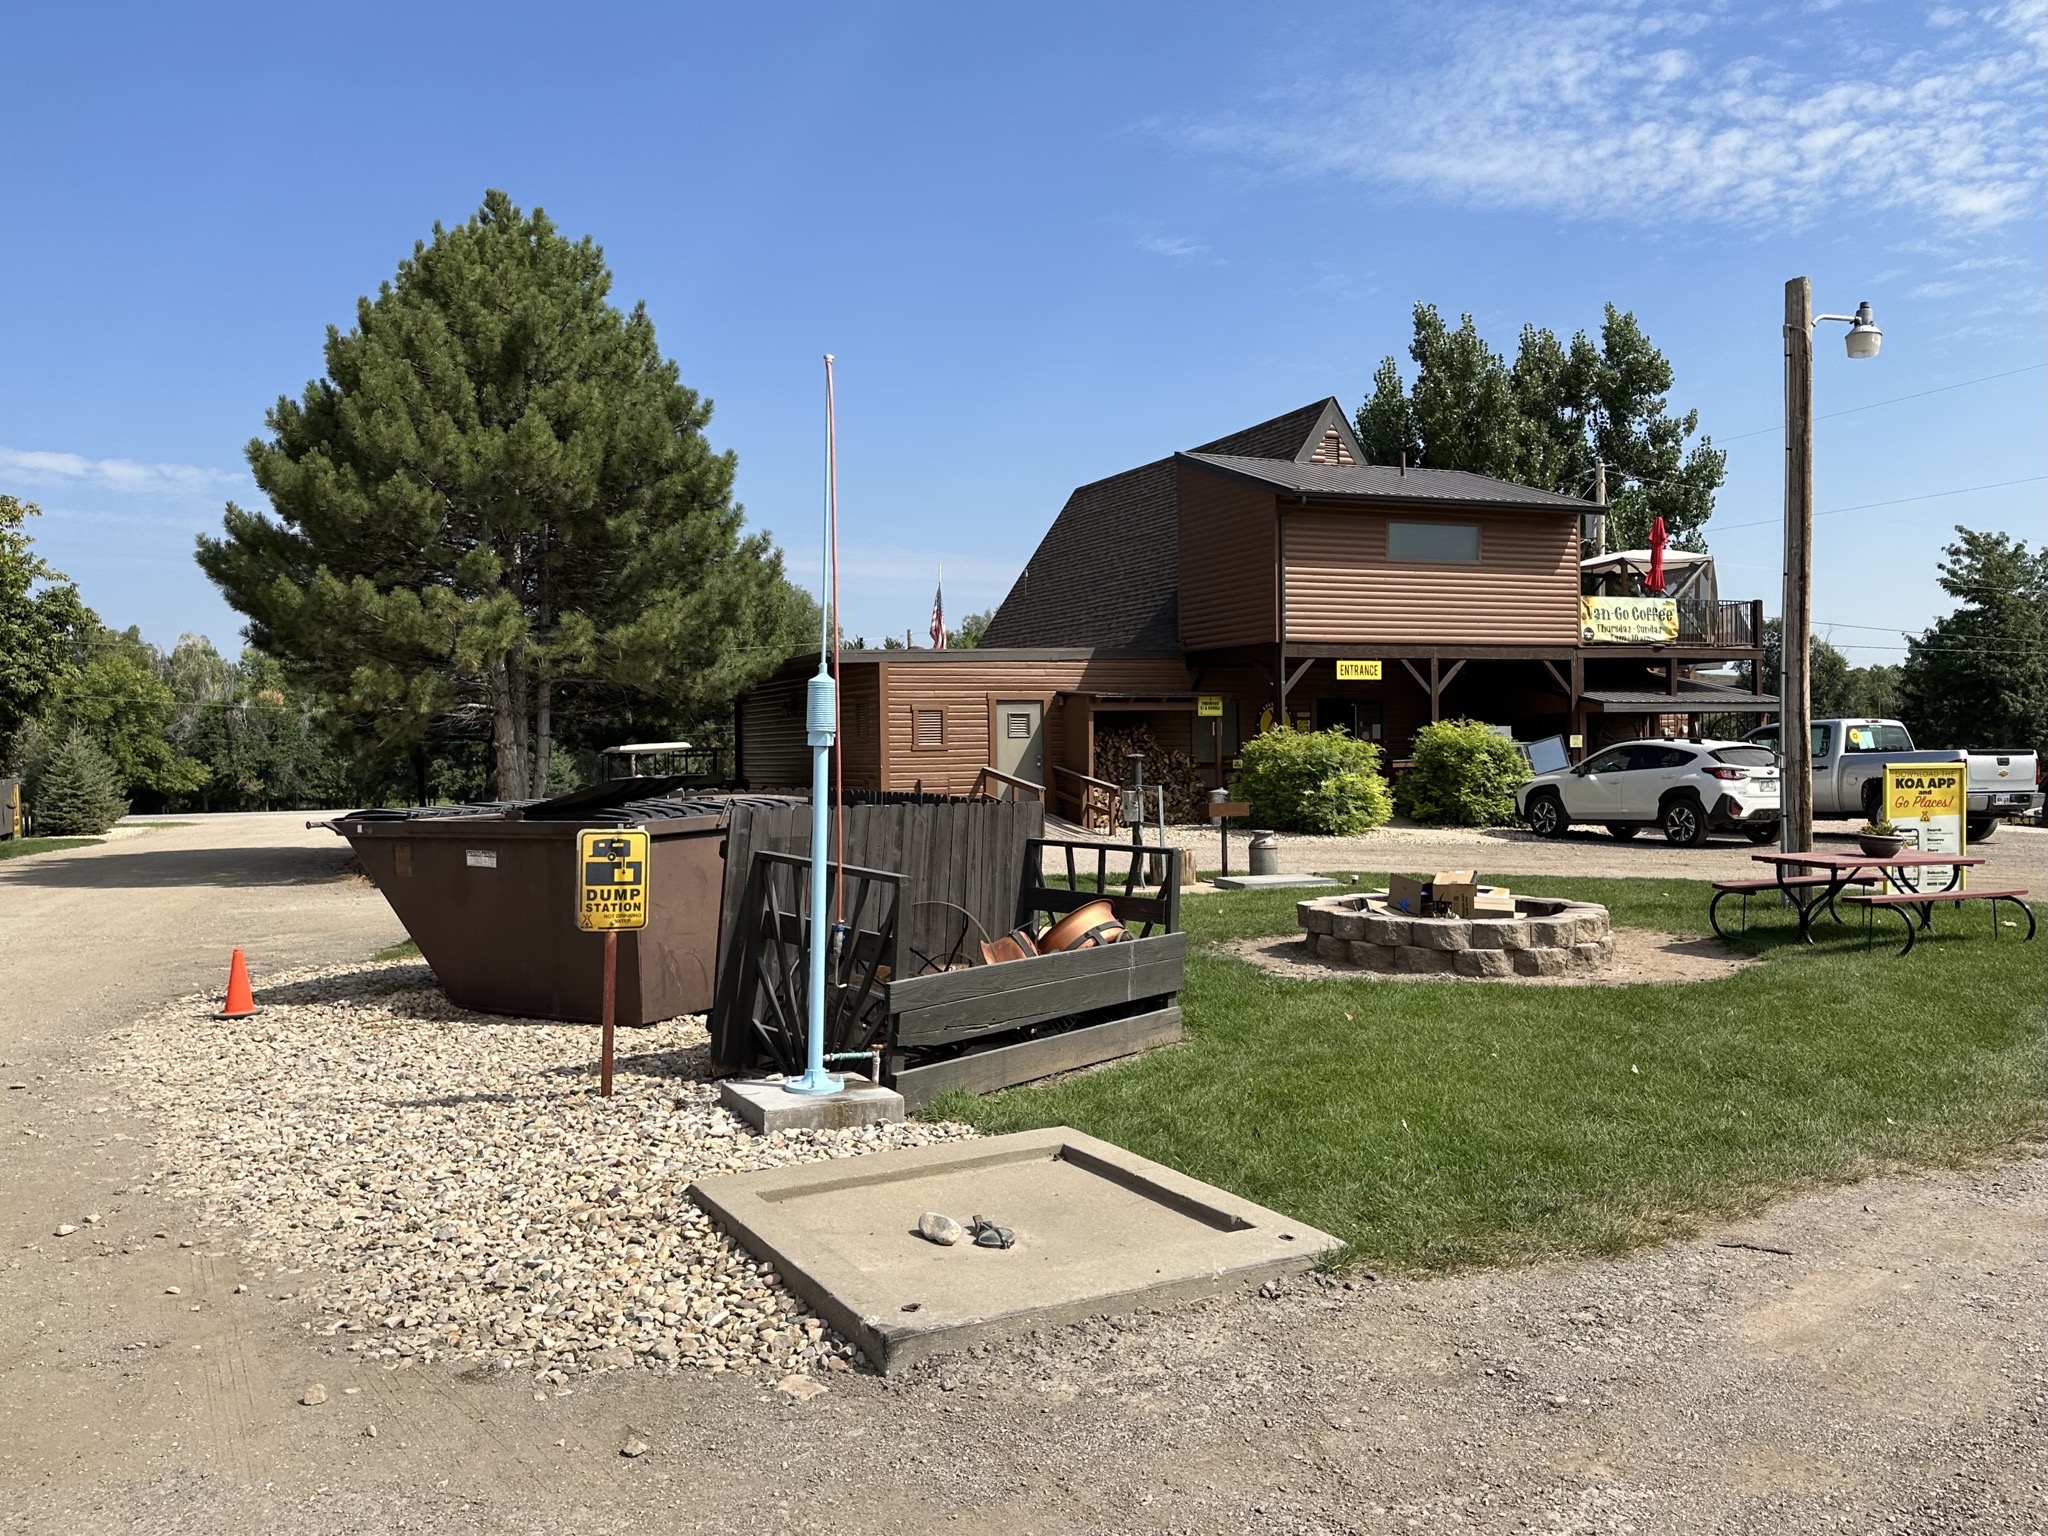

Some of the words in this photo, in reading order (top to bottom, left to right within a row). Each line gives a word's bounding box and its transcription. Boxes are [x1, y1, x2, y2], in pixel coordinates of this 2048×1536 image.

[1631, 606, 1673, 622] Coffee
[1597, 623, 1631, 633] Thursday
[1636, 624, 1662, 634] Sunday
[1340, 664, 1379, 676] ENTRANCE
[1895, 778, 1925, 789] KOA
[1927, 777, 1957, 789] APP
[1895, 795, 1910, 808] Go
[1912, 795, 1955, 808] Places!
[586, 888, 641, 901] DUMP
[585, 902, 641, 912] STATION
